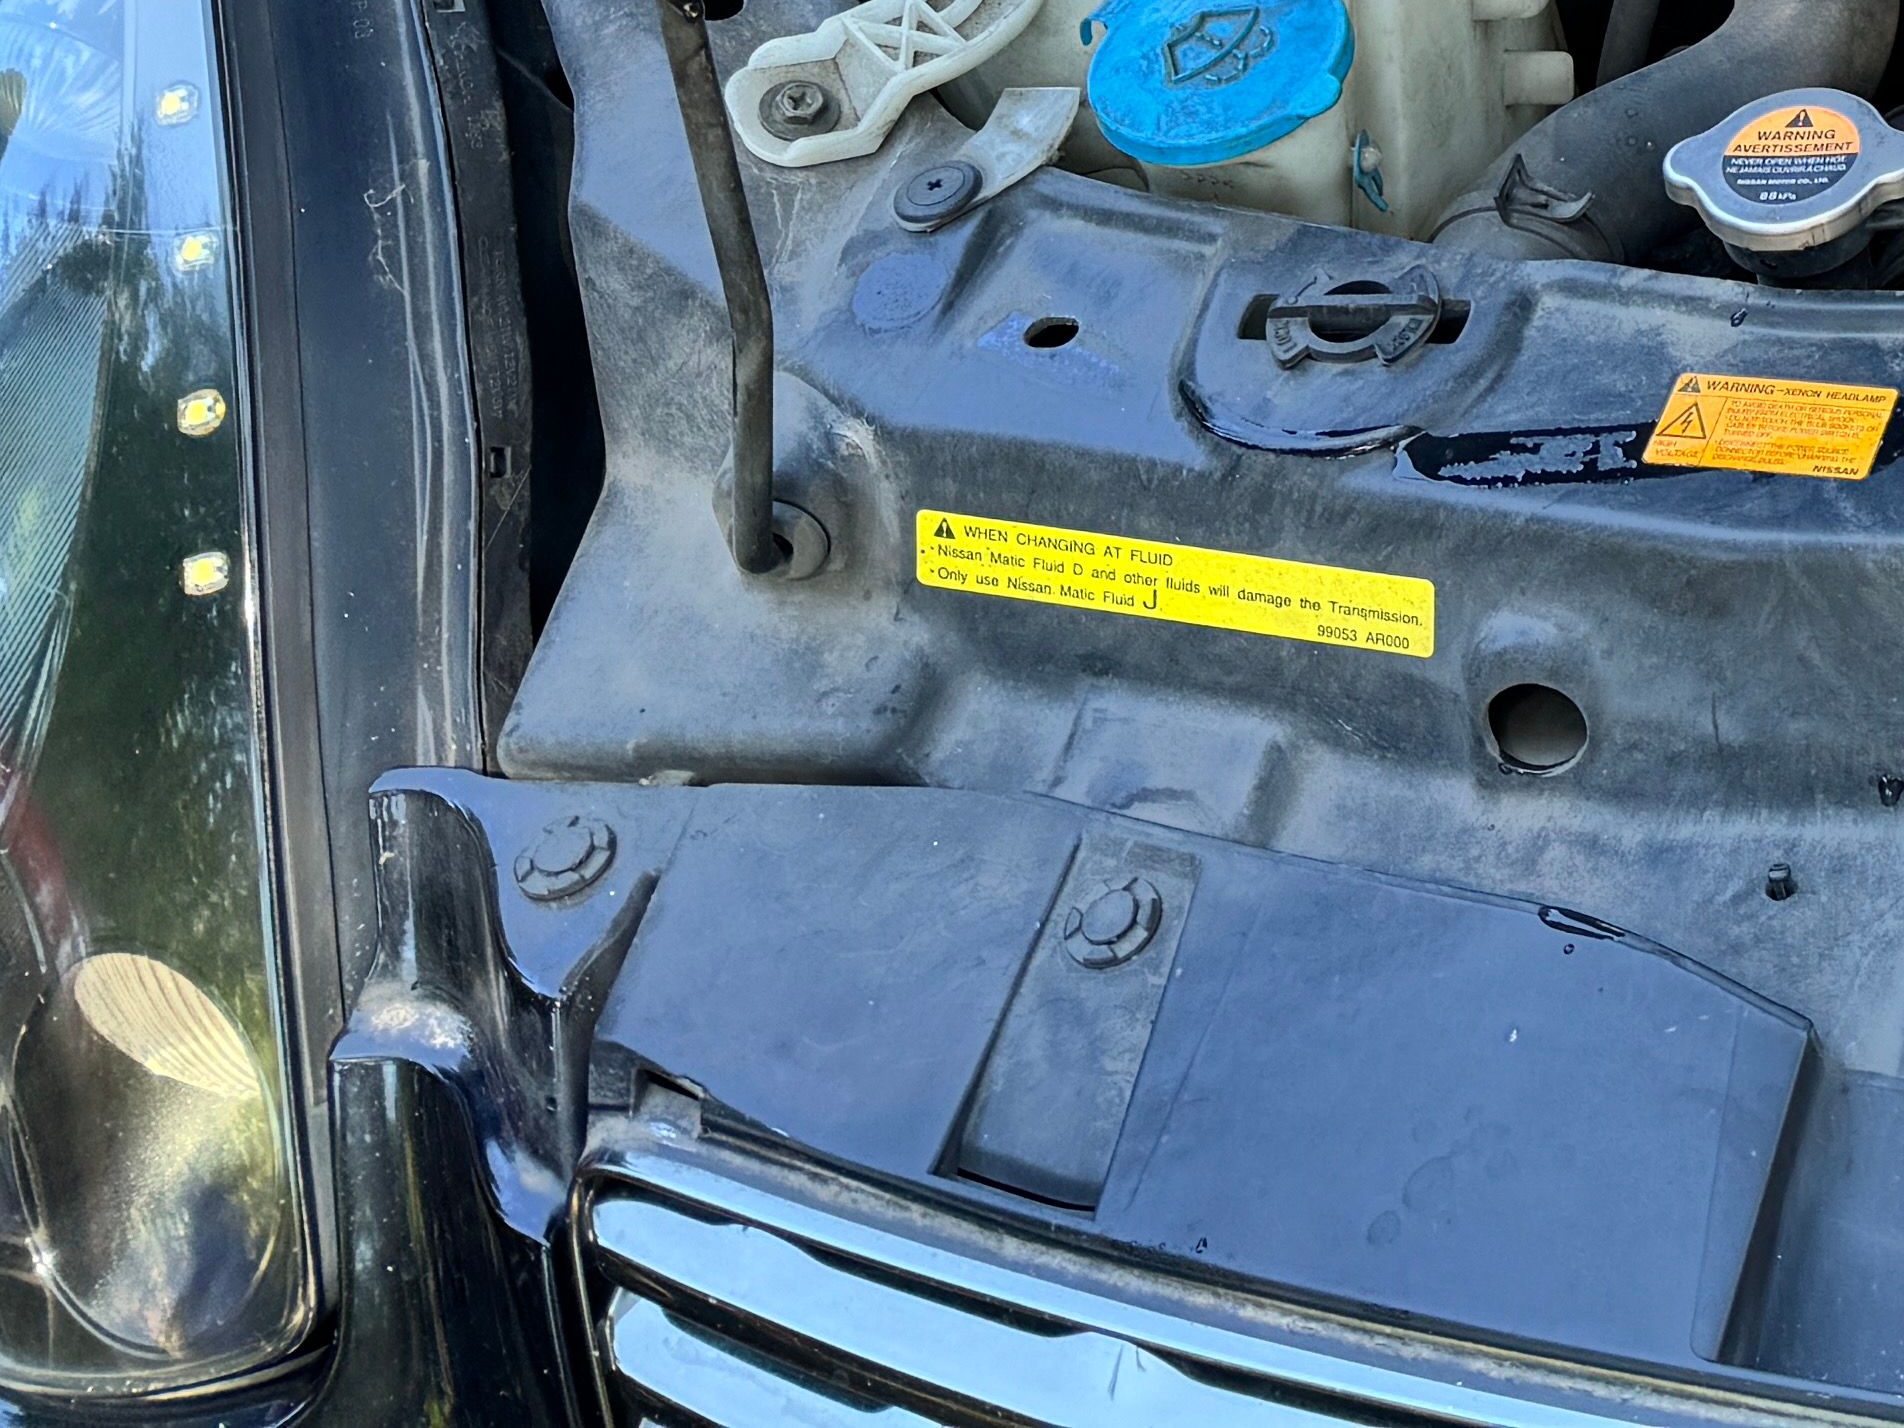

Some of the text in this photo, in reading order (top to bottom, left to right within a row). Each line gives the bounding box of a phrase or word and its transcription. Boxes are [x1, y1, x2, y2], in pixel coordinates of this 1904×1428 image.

[1757, 129, 1835, 141] WARNING
[1732, 140, 1853, 155] AVERTISSEMENT
[1731, 157, 1763, 166] NEVER
[1765, 156, 1791, 165] OPEN
[1794, 155, 1824, 164] WHEN
[1825, 391, 1887, 403] HEADLAMP
[1811, 464, 1859, 475] NISSAN
[963, 524, 1173, 567] WHEN CHANGING AT FLUID
[989, 551, 1025, 569] Matic
[1032, 557, 1064, 574] Fluid
[1073, 563, 1083, 577] D
[1091, 567, 1116, 583] and
[1123, 572, 1157, 588] other
[1165, 578, 1200, 595] fluids
[1208, 584, 1229, 599] will
[1237, 588, 1292, 610] damage
[1298, 597, 1321, 612] the
[976, 574, 999, 588] use
[1060, 583, 1095, 603] Matic
[1103, 589, 1134, 607] Fluid
[1143, 588, 1156, 611] J
[1316, 624, 1410, 650] 99053 AR000
